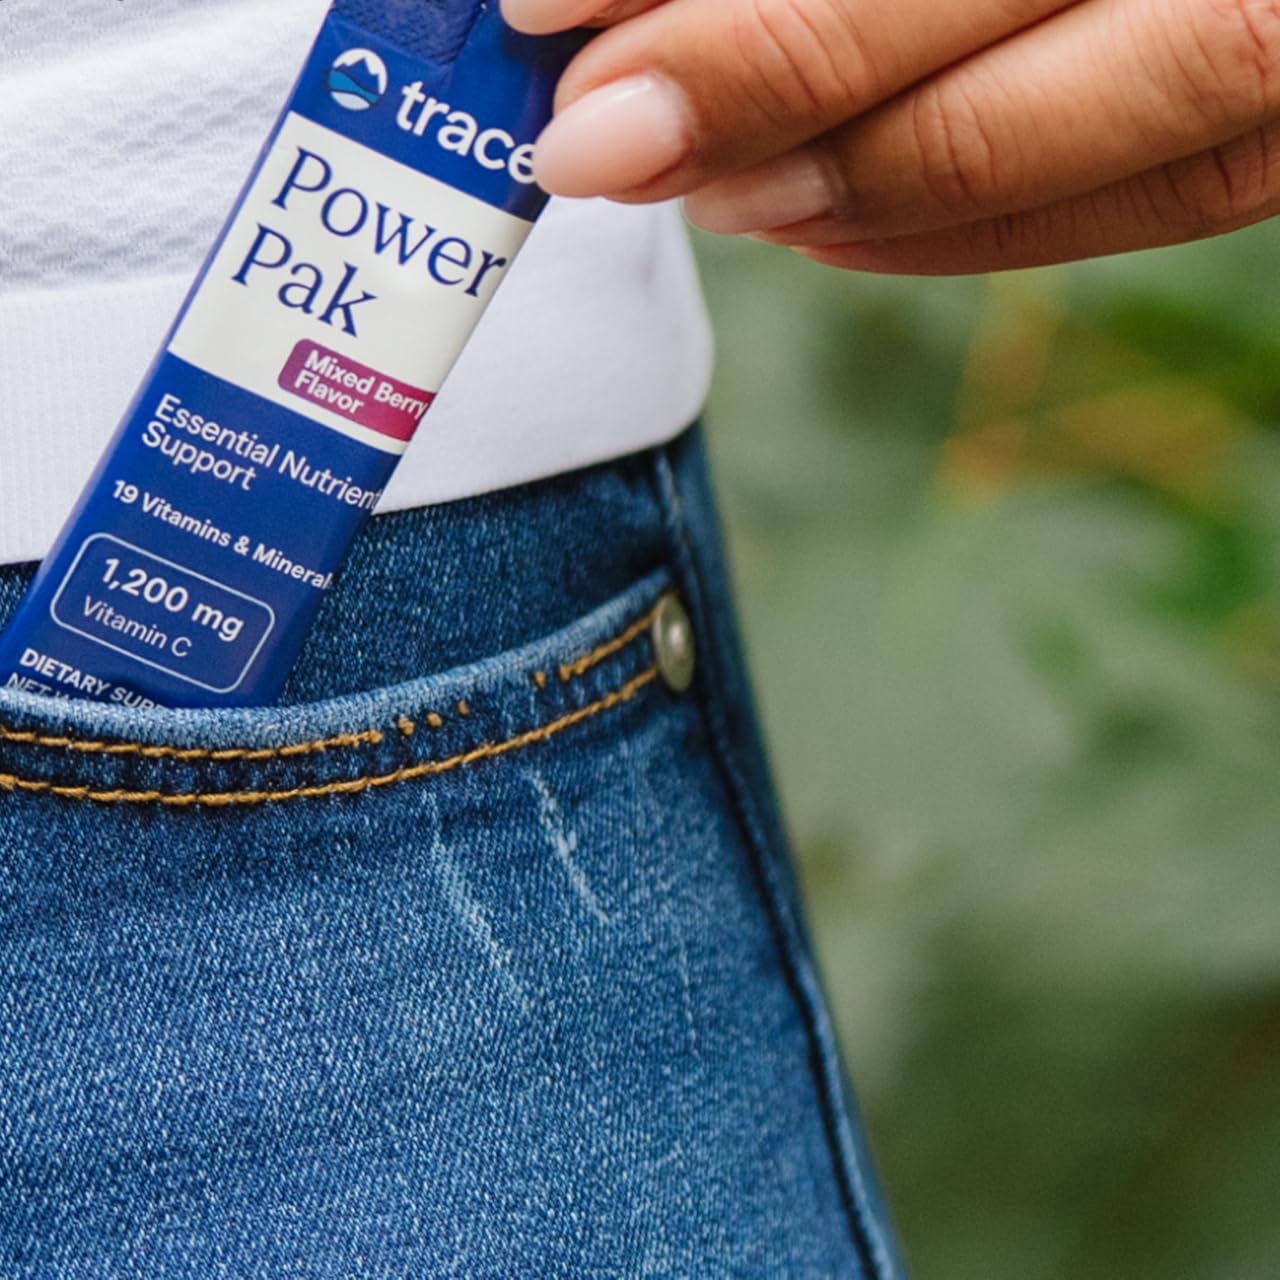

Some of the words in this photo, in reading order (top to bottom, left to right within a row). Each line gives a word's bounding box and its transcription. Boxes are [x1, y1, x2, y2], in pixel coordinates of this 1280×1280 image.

[395, 80, 537, 185] trace
[270, 145, 508, 298] Power
[231, 222, 377, 338] Pak
[294, 369, 365, 415] Flavor
[304, 349, 376, 396] Mixed
[373, 381, 429, 420] Berry
[141, 420, 257, 491] Support
[153, 393, 280, 468] Essential
[112, 479, 139, 504] 19
[141, 491, 232, 547] Vitamins
[233, 535, 250, 557] &
[82, 595, 168, 650] Vitamin
[171, 636, 193, 658] C
[100, 557, 189, 613] 1,200
[191, 602, 245, 642] mg
[19, 647, 111, 697] DIETARY
